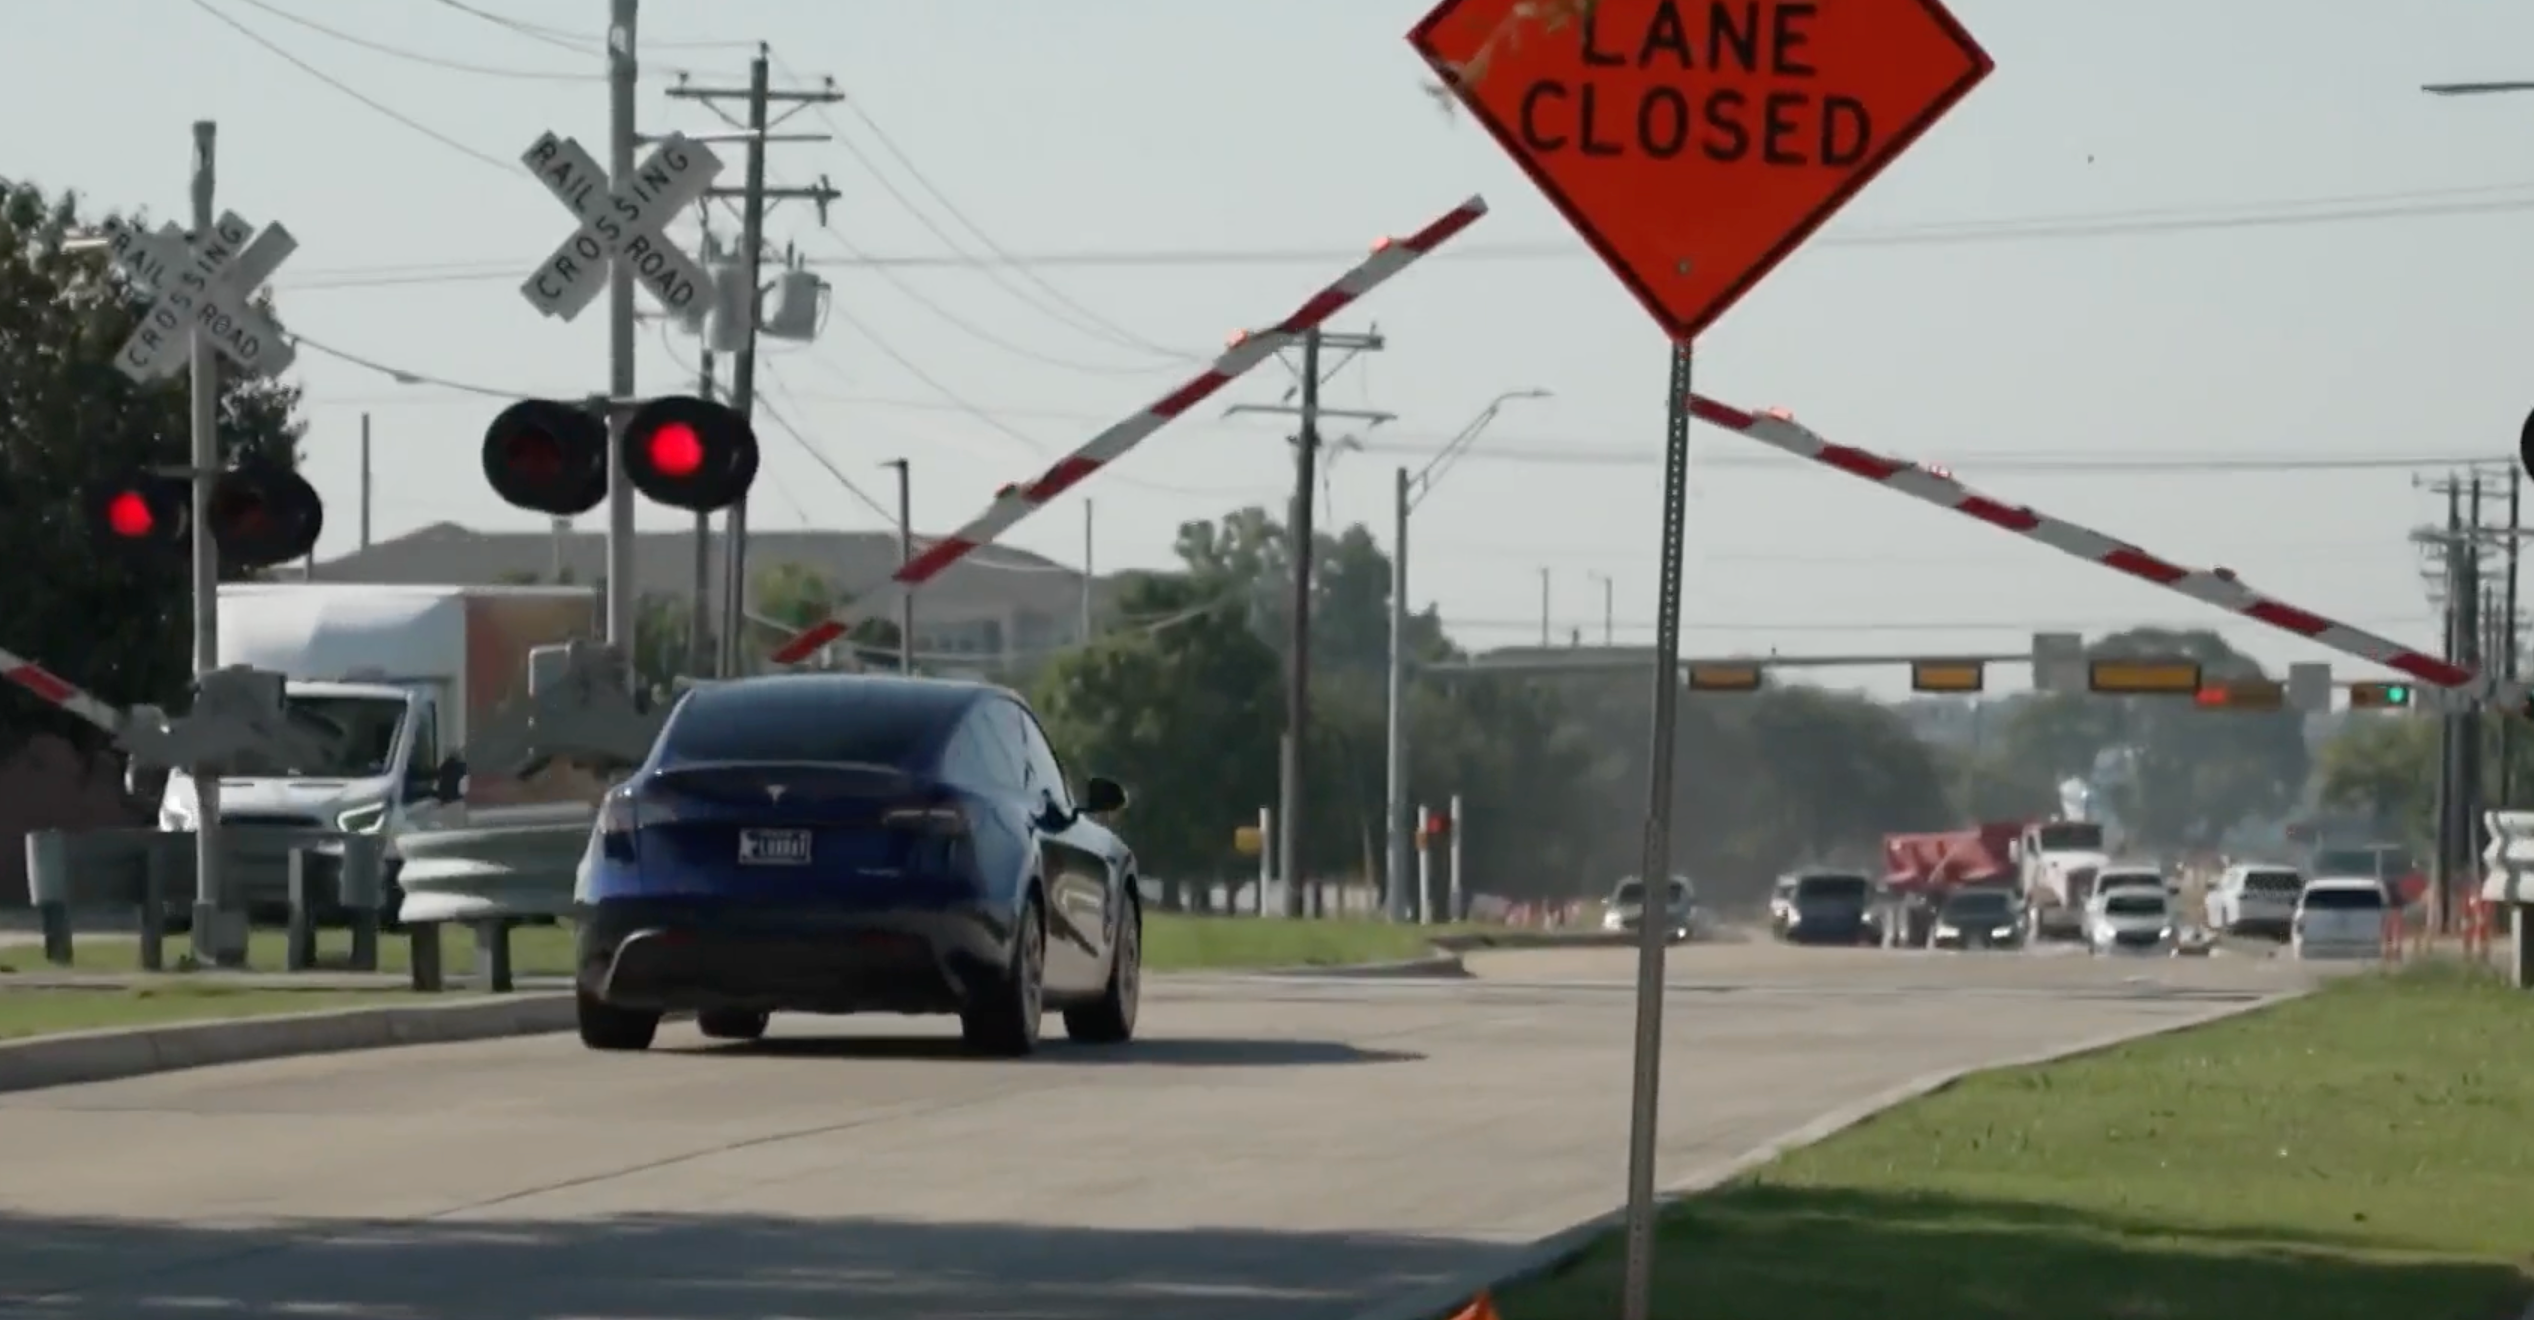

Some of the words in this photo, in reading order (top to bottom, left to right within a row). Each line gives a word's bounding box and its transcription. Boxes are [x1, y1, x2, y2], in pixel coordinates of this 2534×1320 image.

[1580, 0, 1818, 77] LANE
[1519, 80, 1872, 167] CLOSED
[532, 140, 593, 214] RAIL
[623, 235, 694, 307] ROAD
[537, 149, 688, 299] CROSSING
[113, 232, 165, 289] RAIL
[198, 302, 259, 359] ROAD
[128, 224, 243, 368] CROSSING
